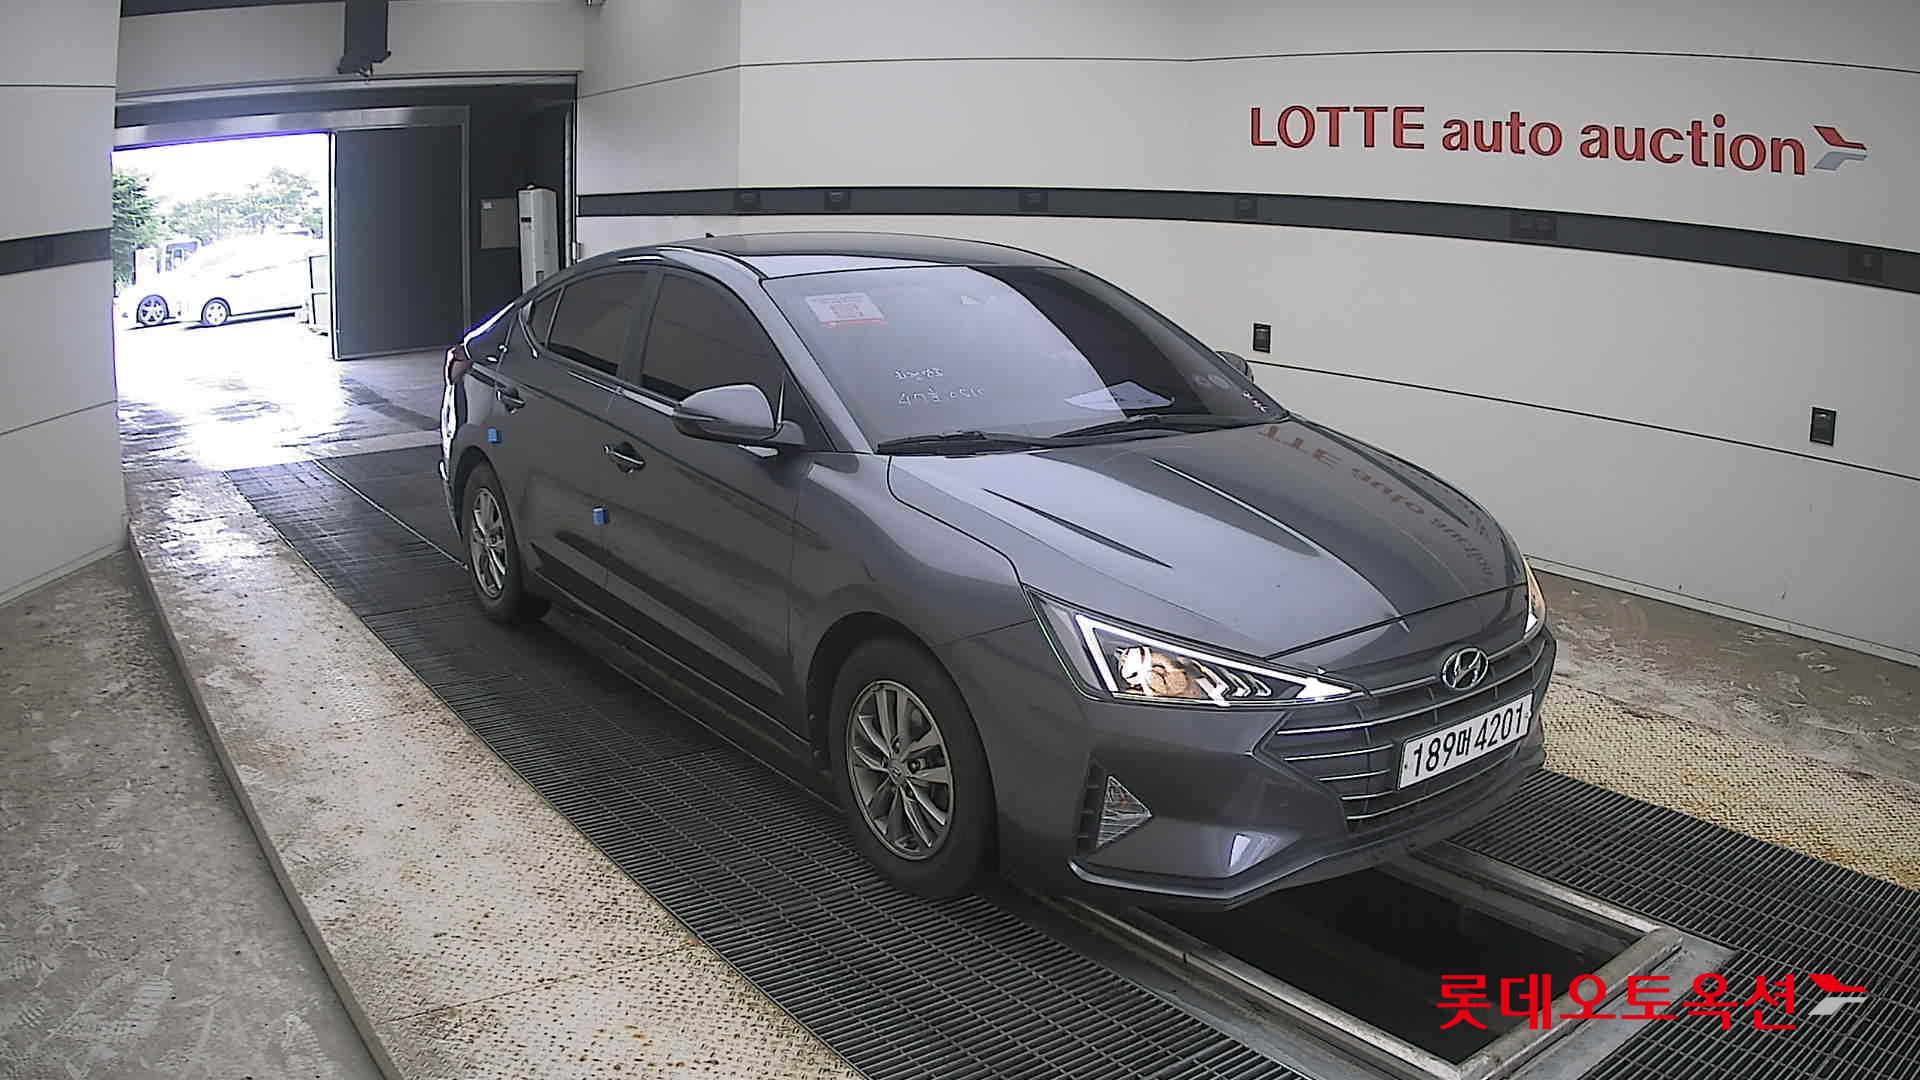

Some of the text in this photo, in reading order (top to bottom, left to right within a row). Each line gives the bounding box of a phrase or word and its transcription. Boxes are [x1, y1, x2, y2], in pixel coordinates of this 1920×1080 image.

[1251, 106, 1805, 176] LOTTE auto auction
[1414, 702, 1524, 777] 189머 4201
